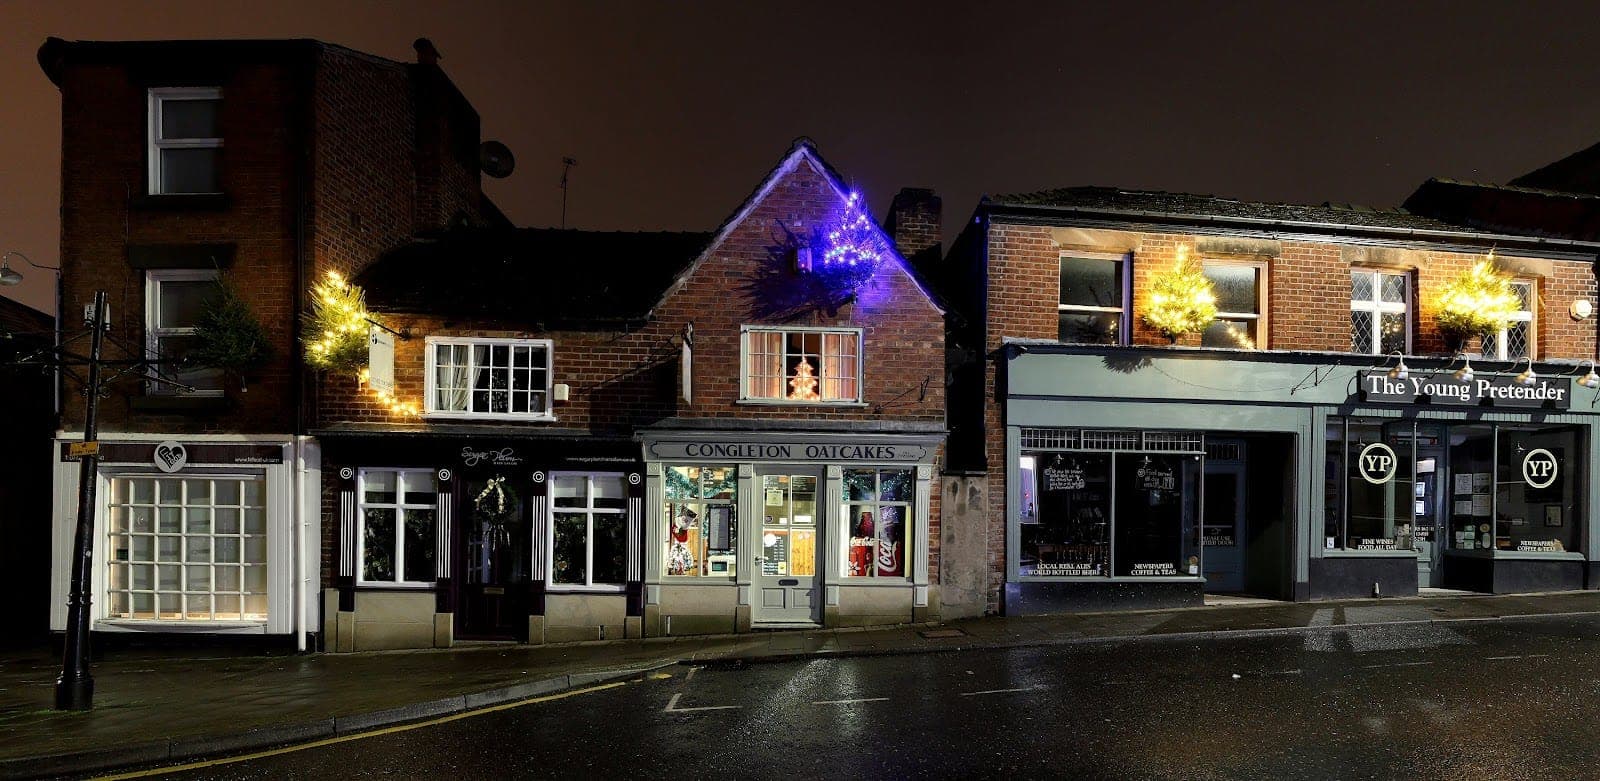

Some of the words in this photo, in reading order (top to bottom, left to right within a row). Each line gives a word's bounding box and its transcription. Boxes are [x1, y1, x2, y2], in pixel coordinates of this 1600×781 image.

[1366, 375, 1406, 395] The
[1409, 377, 1471, 401] Young
[1475, 379, 1566, 401] Pretender
[685, 443, 792, 458] CONGLETON
[805, 444, 896, 459] OATCAKES
[1365, 455, 1392, 472] YP
[1527, 460, 1553, 477] YP
[1134, 562, 1174, 570] NEWSPAPERS
[1160, 568, 1177, 576] TEAS
